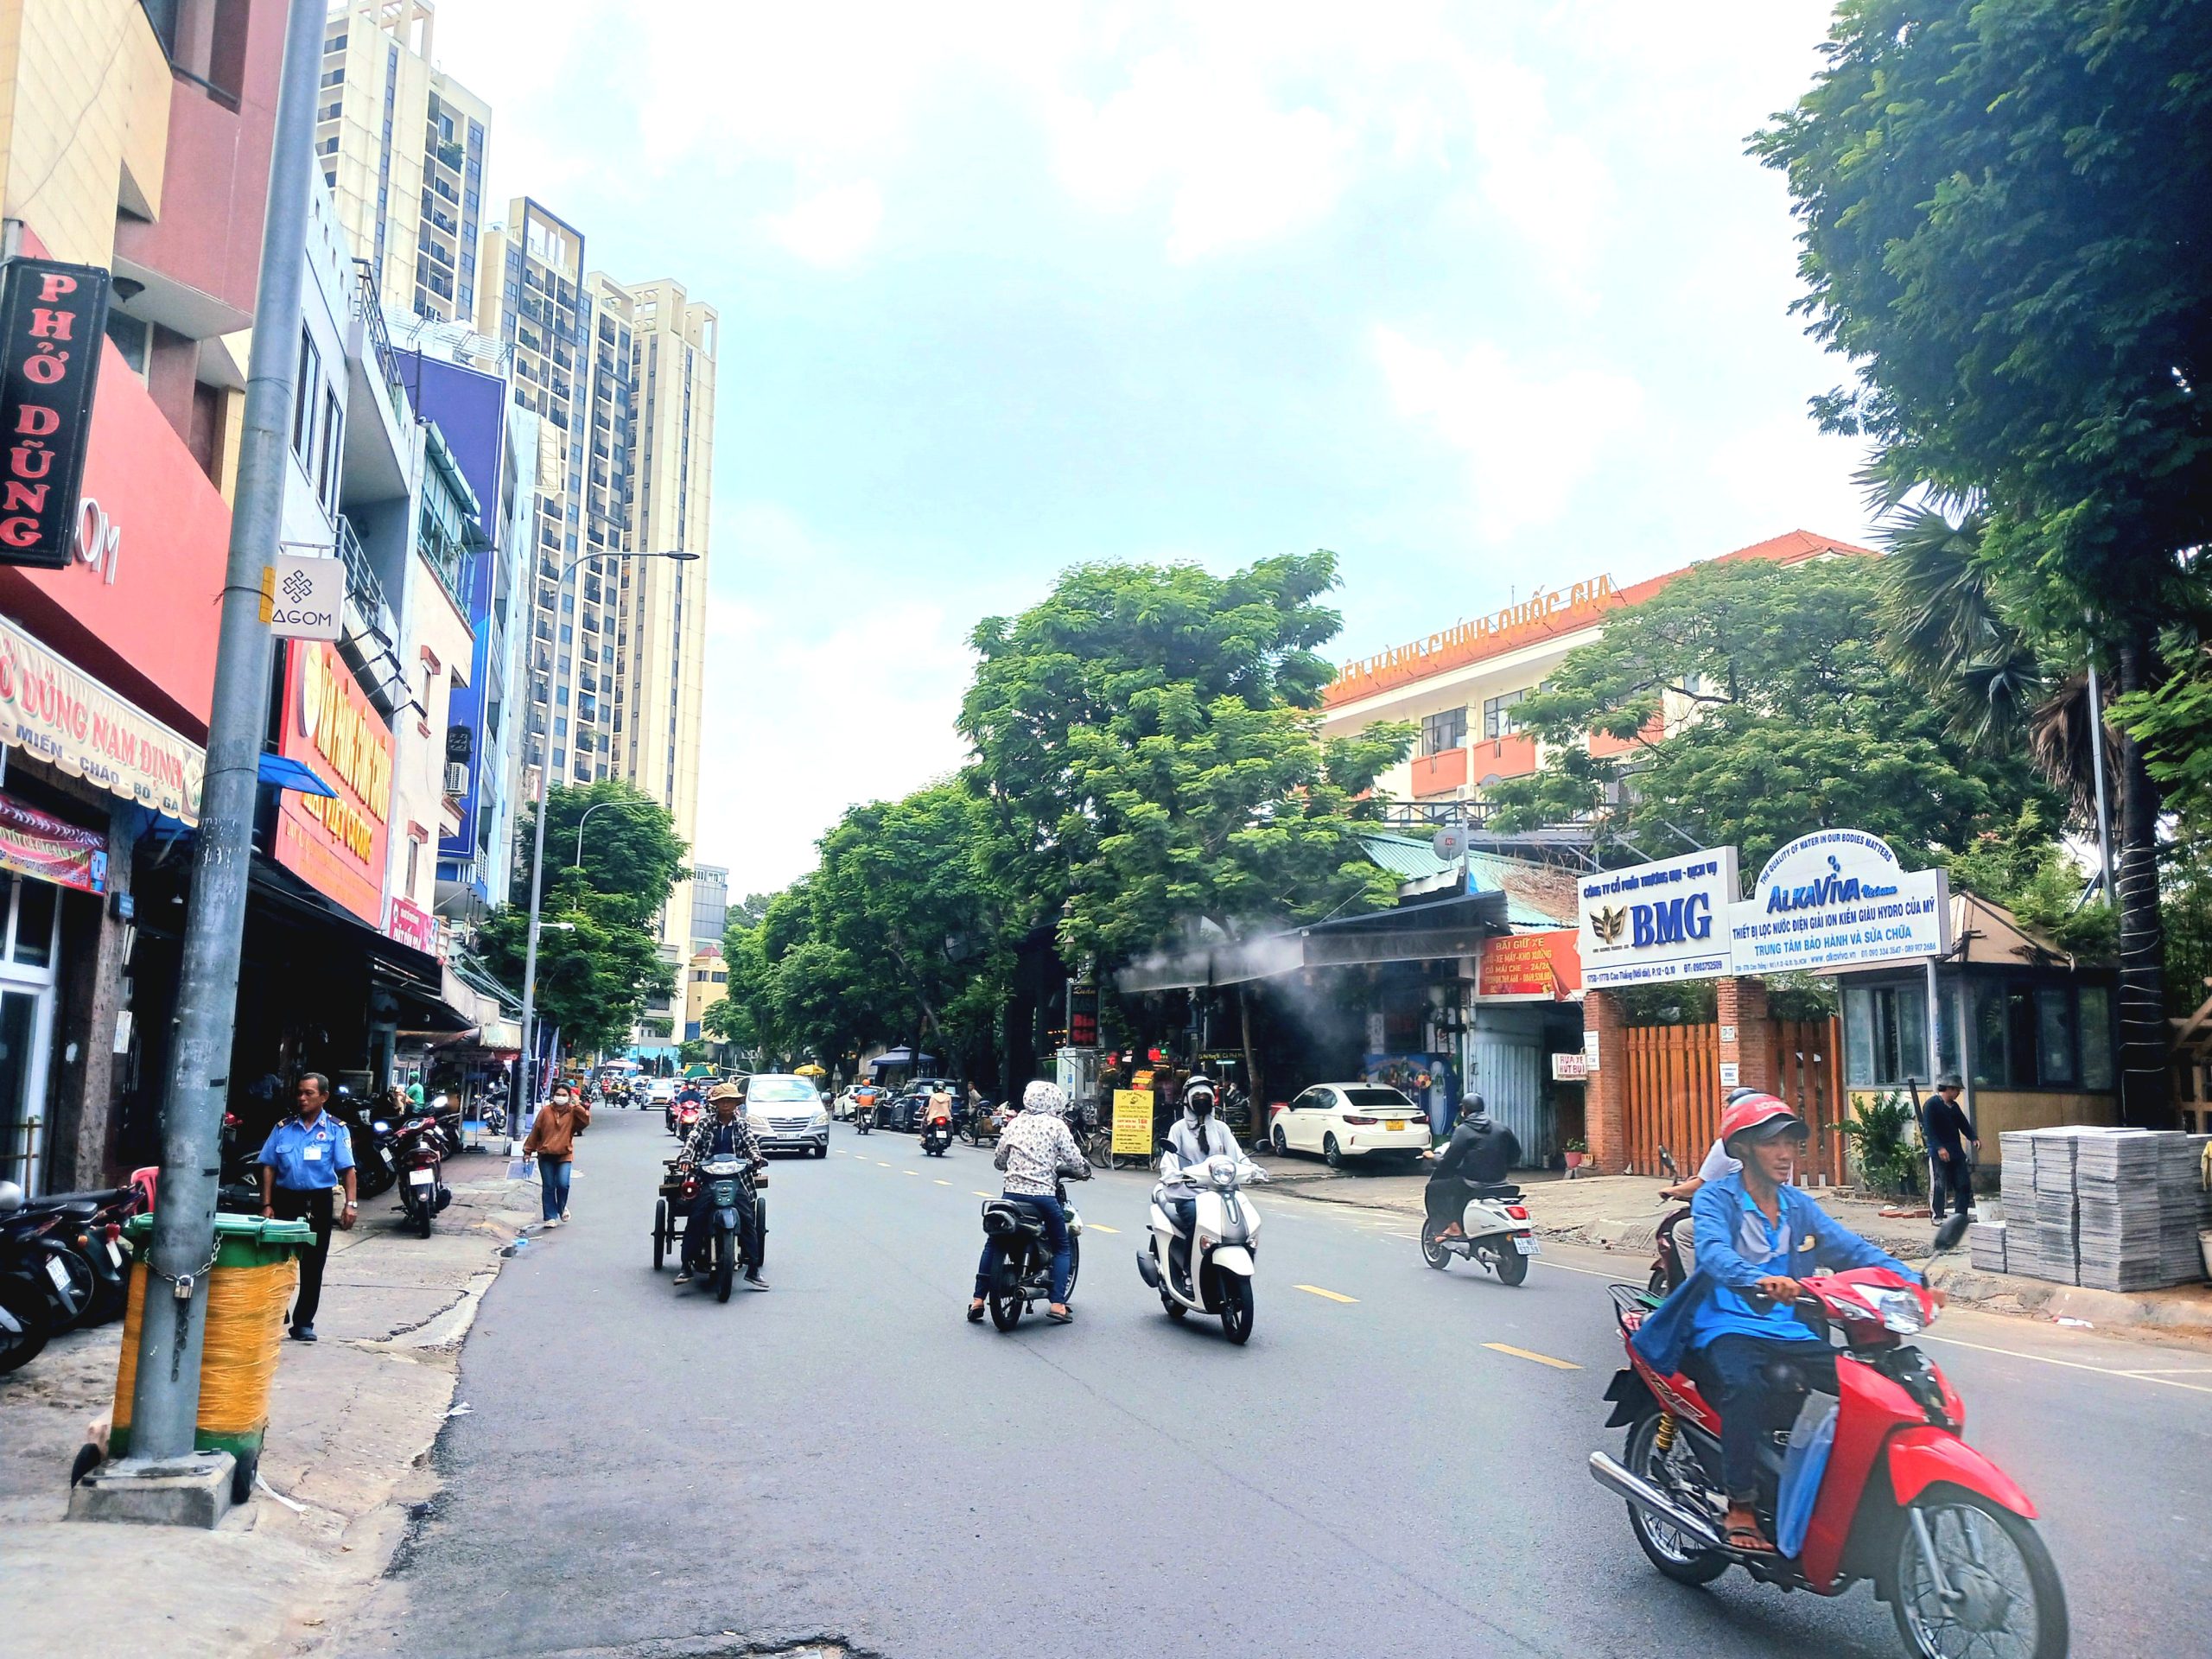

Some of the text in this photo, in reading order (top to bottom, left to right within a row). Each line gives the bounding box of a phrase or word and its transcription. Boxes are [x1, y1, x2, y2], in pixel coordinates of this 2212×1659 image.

[0, 273, 77, 547] PHỞ DŨNG
[75, 497, 120, 586] OM
[1427, 616, 1489, 664] CHÍNH
[1498, 584, 1560, 640] QUỐC
[1571, 574, 1611, 617] GIA
[21, 667, 87, 741] DŨNG
[92, 710, 136, 767] NAM
[140, 739, 183, 791] ĐỊNH
[79, 756, 120, 785] CHÁO
[1759, 833, 1892, 885] THE QUALITY OF WATER IN OUR BODIES MATTERS
[1532, 937, 1545, 947] XE
[1630, 892, 1713, 949] BMG
[1754, 924, 1912, 957] TRUNG TÂM BẢO HÀNH VÀ SỬA CHỮA
[1759, 924, 1772, 939] LỌC
[1825, 916, 1838, 928] ION
[1878, 904, 1904, 919] HYDRO
[1905, 896, 1922, 915] CỦA
[1509, 964, 1521, 973] CHE
